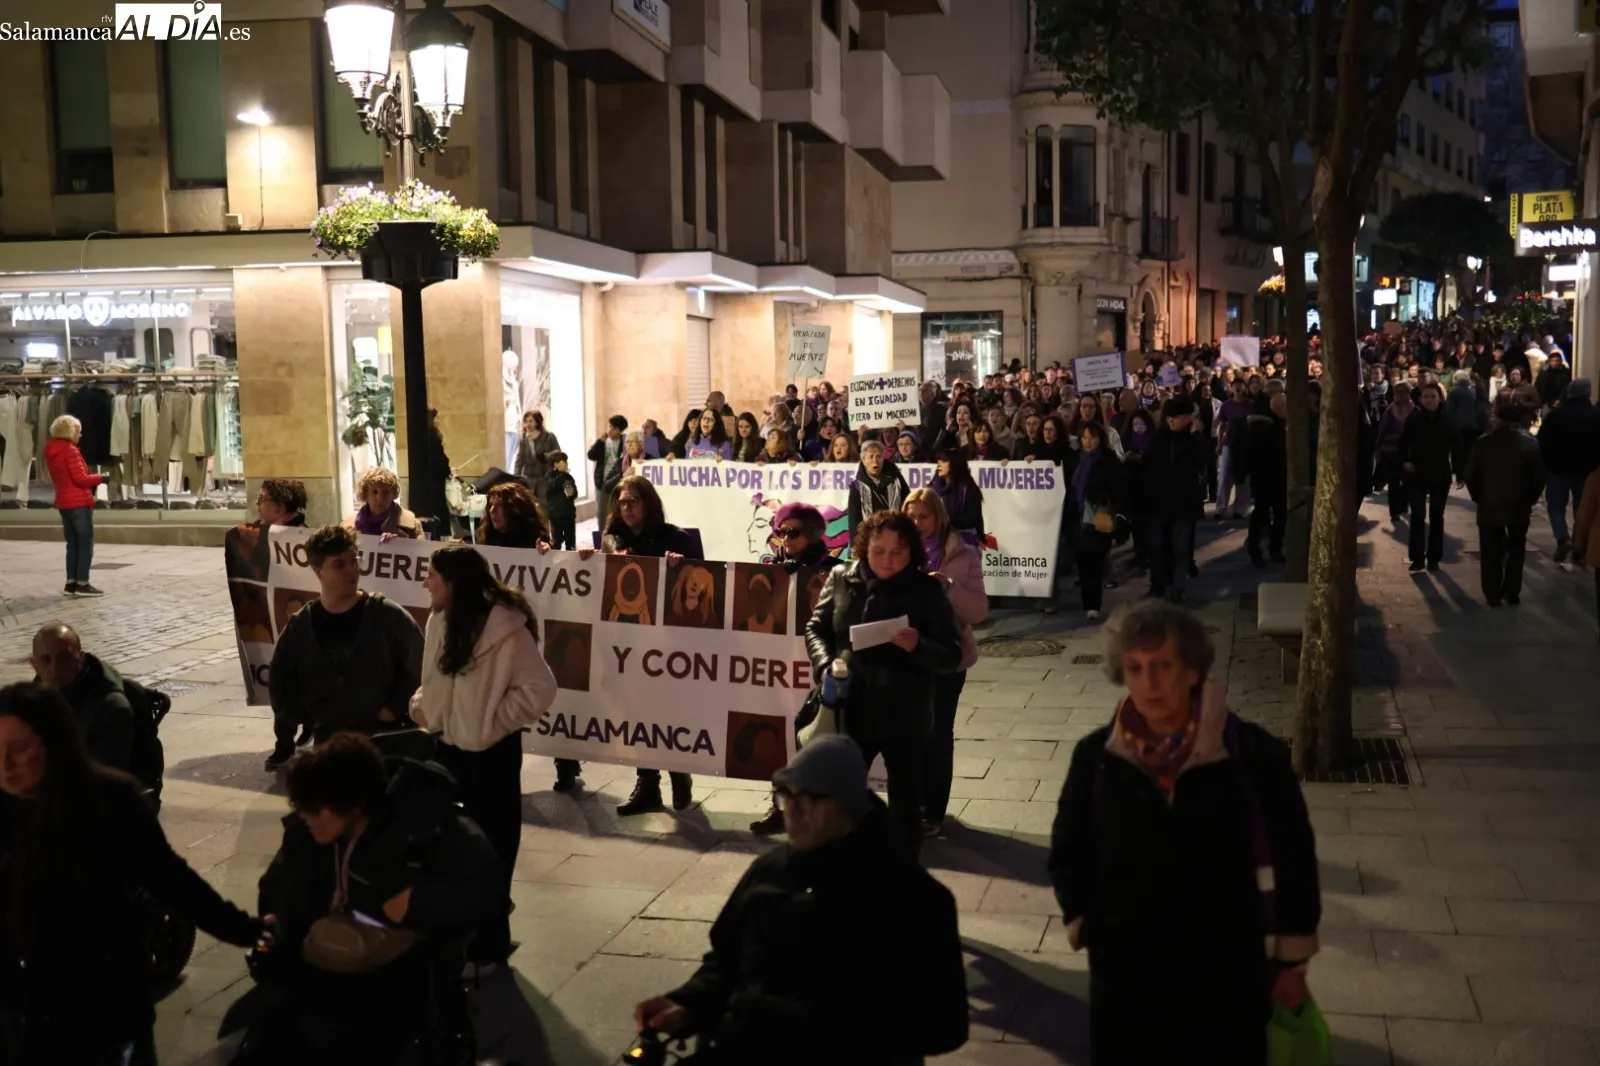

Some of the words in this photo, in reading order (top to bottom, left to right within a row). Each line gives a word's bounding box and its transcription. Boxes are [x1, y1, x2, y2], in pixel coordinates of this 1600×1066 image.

[1533, 202, 1564, 214] PLATA
[1519, 224, 1597, 249] Bershka
[13, 303, 83, 321] ALVARO
[111, 302, 190, 319] MORENO
[803, 342, 814, 350] DE
[789, 352, 826, 362] MUERTE
[887, 376, 916, 389] DERECHOS
[855, 397, 866, 407] EN
[868, 392, 908, 406] IGUALDAD
[849, 413, 855, 422] Y
[855, 411, 871, 422] CERO
[874, 411, 883, 420] EN
[886, 408, 917, 420] MACHISMO
[641, 465, 664, 486] EN
[669, 466, 722, 488] LUCHA
[726, 468, 763, 490] POR
[909, 468, 932, 489] DE
[978, 467, 1055, 490] MUJERES
[985, 553, 1047, 568] Salamanca
[493, 563, 592, 598] VIVAS
[983, 569, 1009, 577] zación
[1024, 570, 1049, 580] Mujer
[612, 646, 632, 674] Y
[642, 649, 718, 682] CON
[536, 710, 716, 757] SALAMANCA
